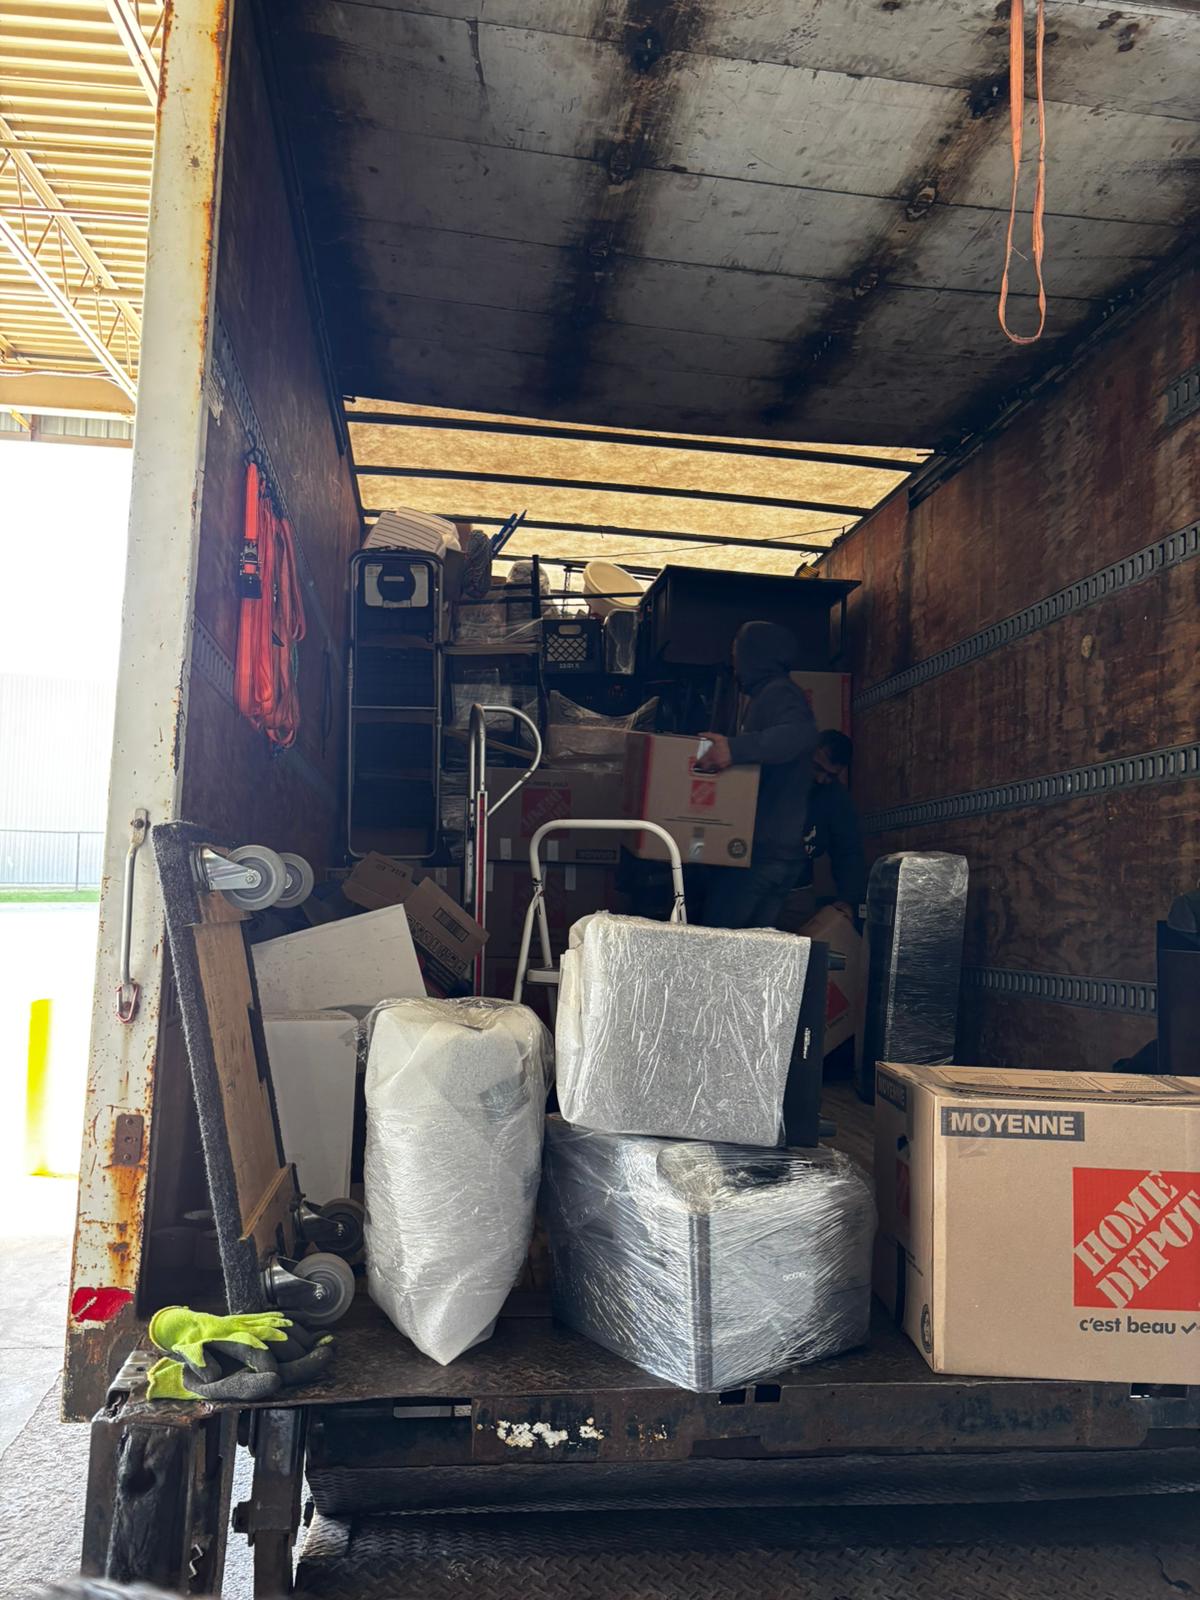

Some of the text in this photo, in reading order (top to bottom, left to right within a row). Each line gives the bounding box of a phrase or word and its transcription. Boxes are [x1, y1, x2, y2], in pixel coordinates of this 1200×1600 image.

[950, 1111, 1075, 1136] MOYENNE
[1073, 1170, 1179, 1277] HOME
[1096, 1190, 1200, 1309] DEPOT
[1079, 1316, 1176, 1334] c'est beau
